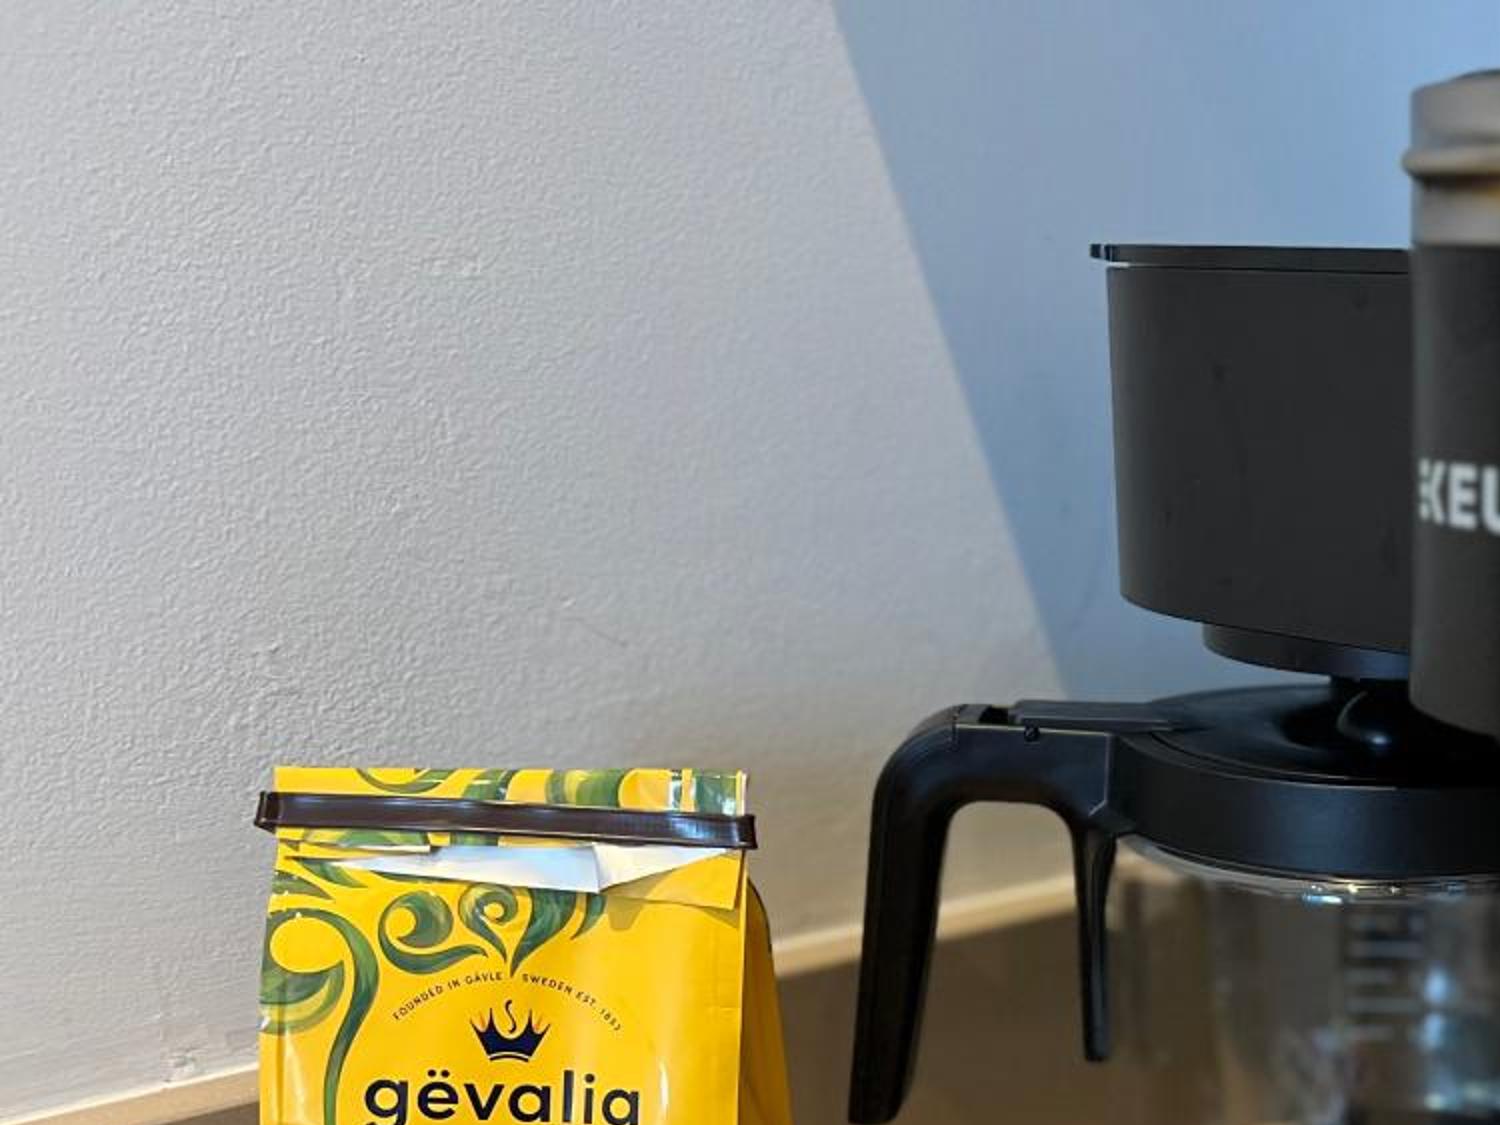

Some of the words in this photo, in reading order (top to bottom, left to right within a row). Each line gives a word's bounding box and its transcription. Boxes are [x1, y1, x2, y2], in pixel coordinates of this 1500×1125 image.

[392, 984, 443, 1021] FOUNDED
[447, 978, 461, 991] IN
[522, 973, 573, 995] SWEDEN
